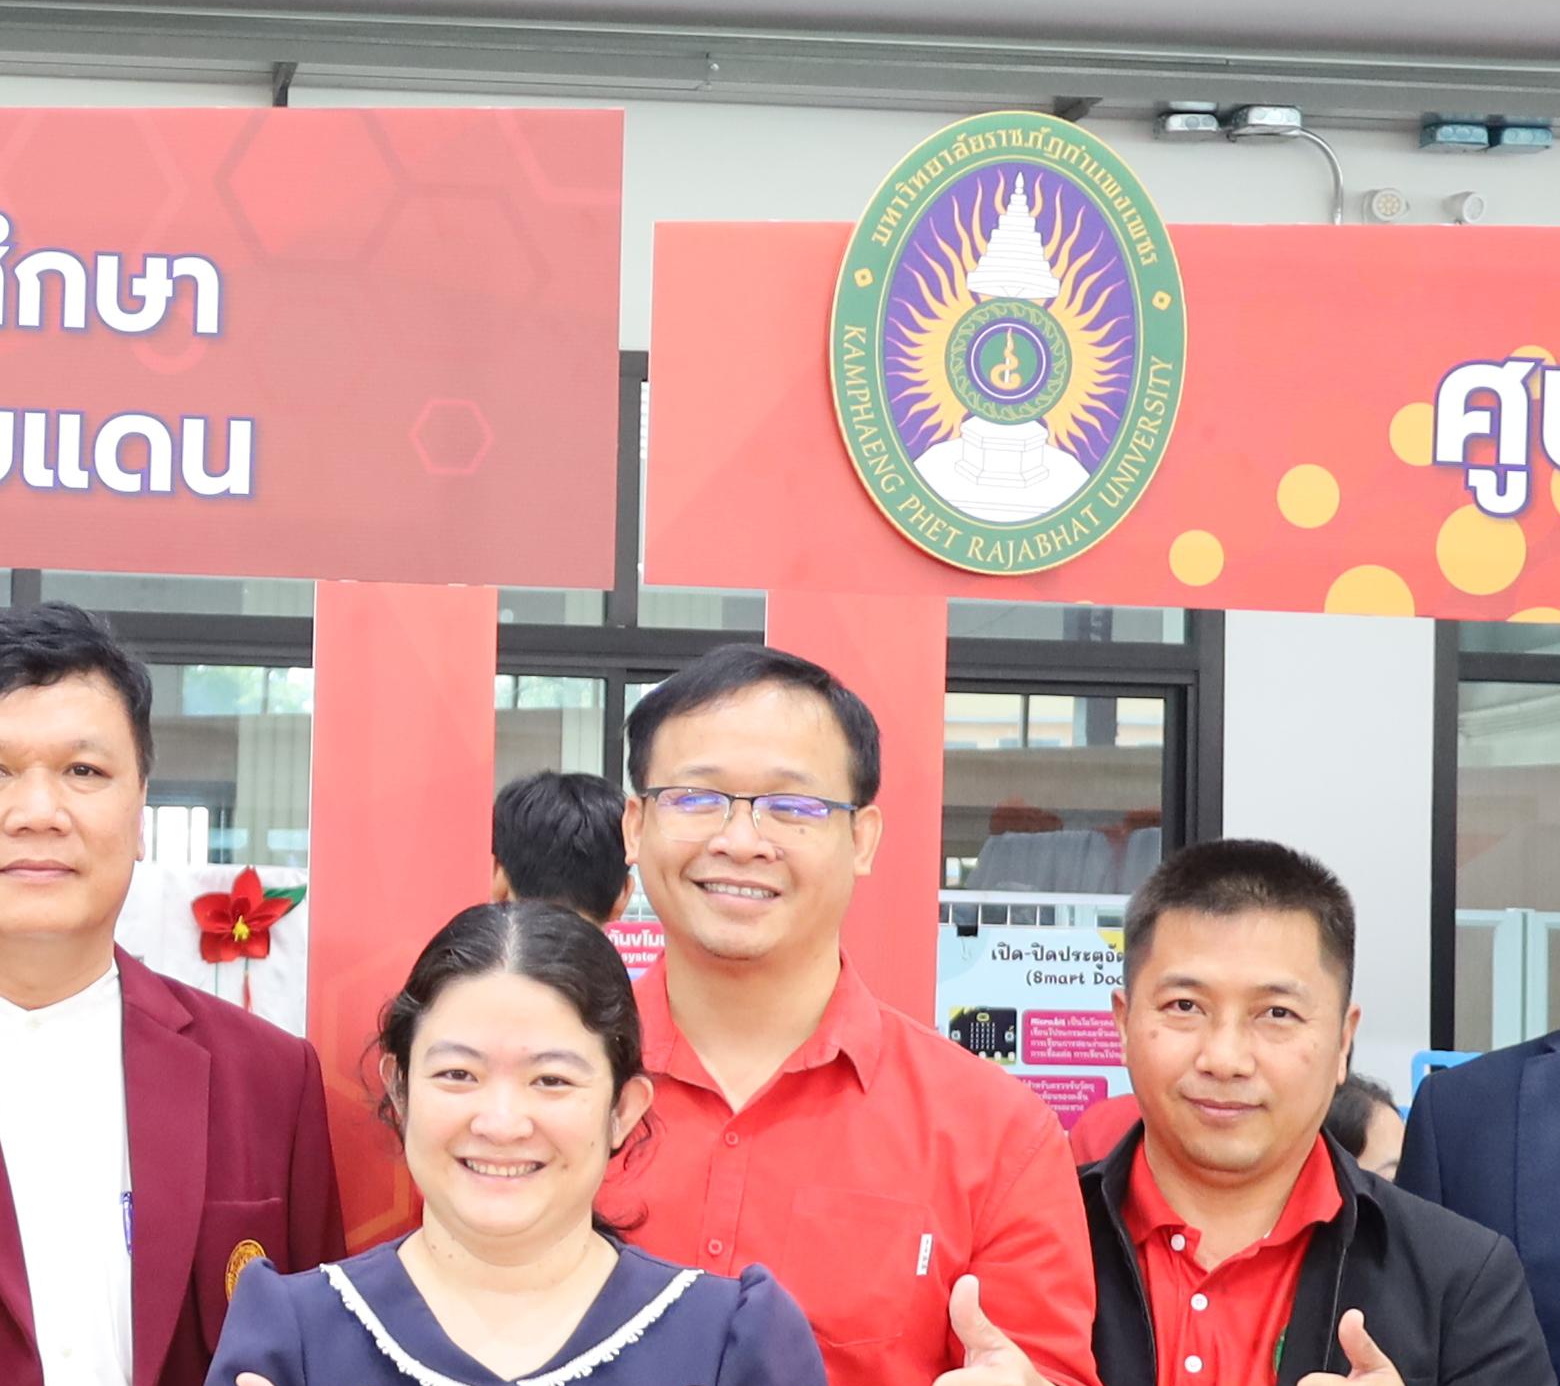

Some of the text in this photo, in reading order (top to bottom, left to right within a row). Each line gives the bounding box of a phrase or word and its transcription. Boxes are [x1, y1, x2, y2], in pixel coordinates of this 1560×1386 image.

[842, 324, 1174, 570] KAMPHAENG PHET RAJABHAT UNIVERSITY
